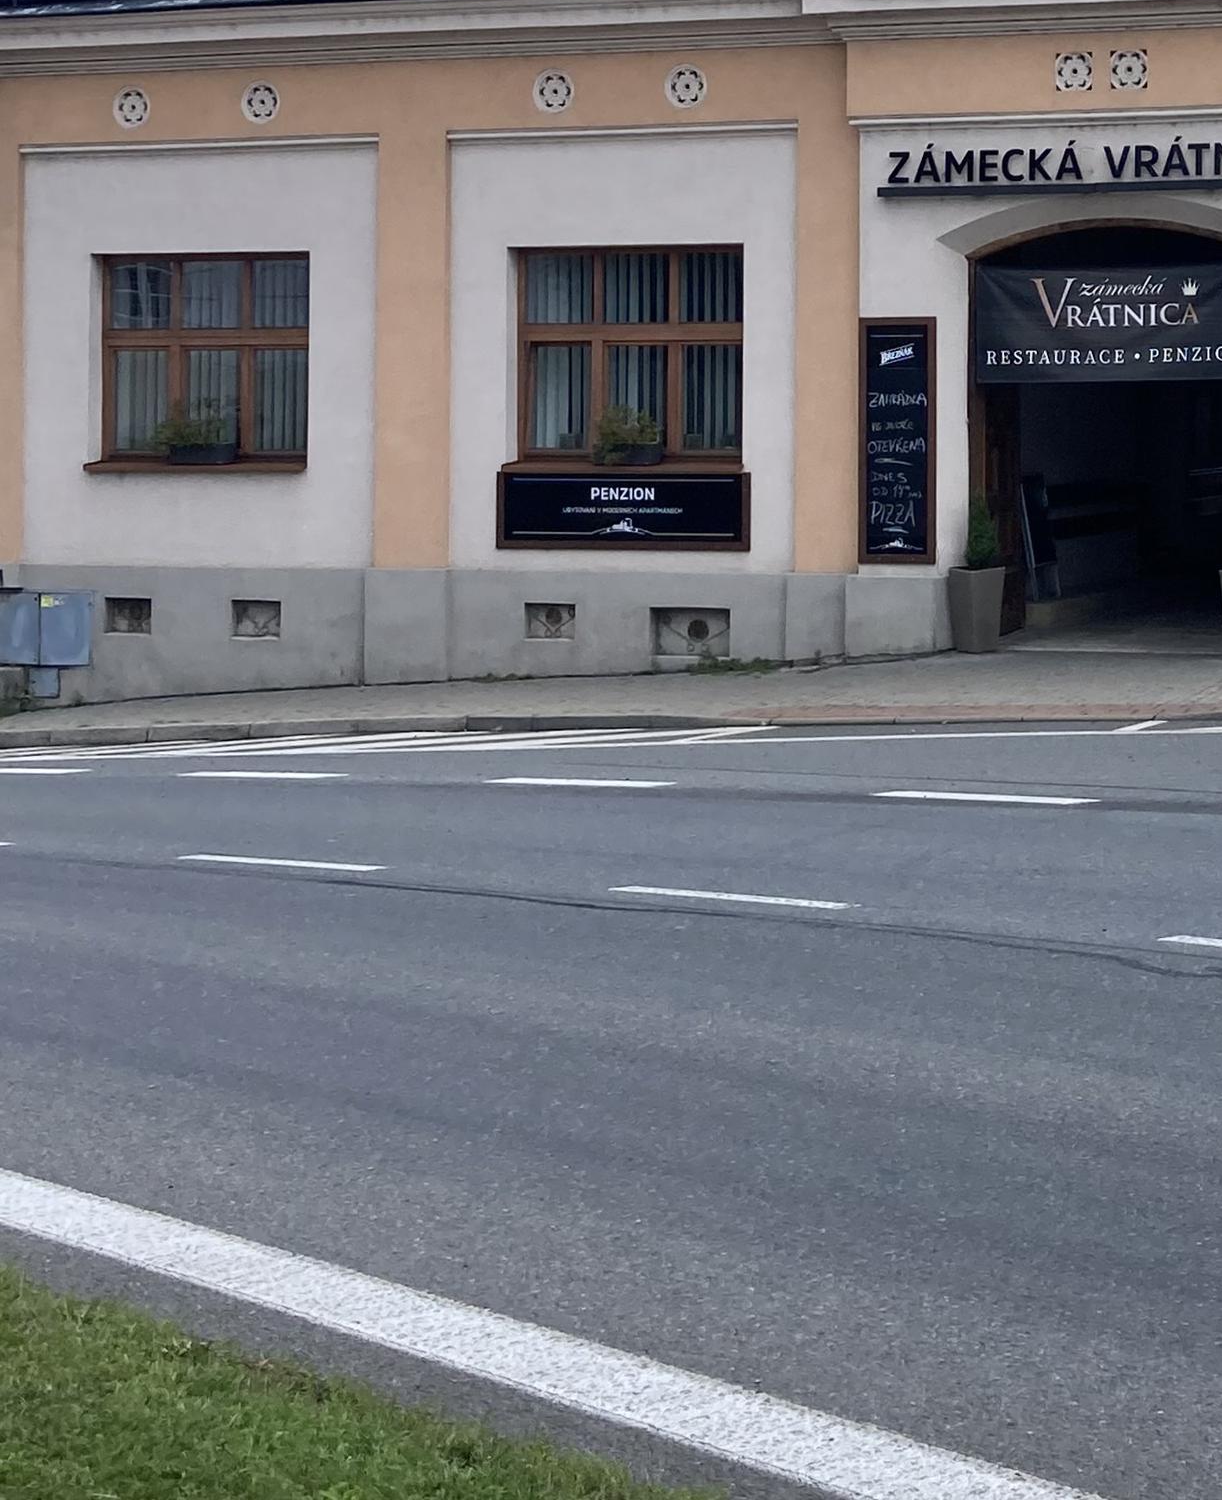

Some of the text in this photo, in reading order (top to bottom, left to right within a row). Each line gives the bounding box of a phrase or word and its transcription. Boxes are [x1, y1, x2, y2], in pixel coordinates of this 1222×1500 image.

[887, 139, 1083, 185] ZÁMECKÁ
[1029, 277, 1200, 328] VRÁTNICA
[985, 348, 1125, 366] RESTAURACE
[590, 487, 655, 501] PENZION
[870, 500, 916, 527] PIZZA
